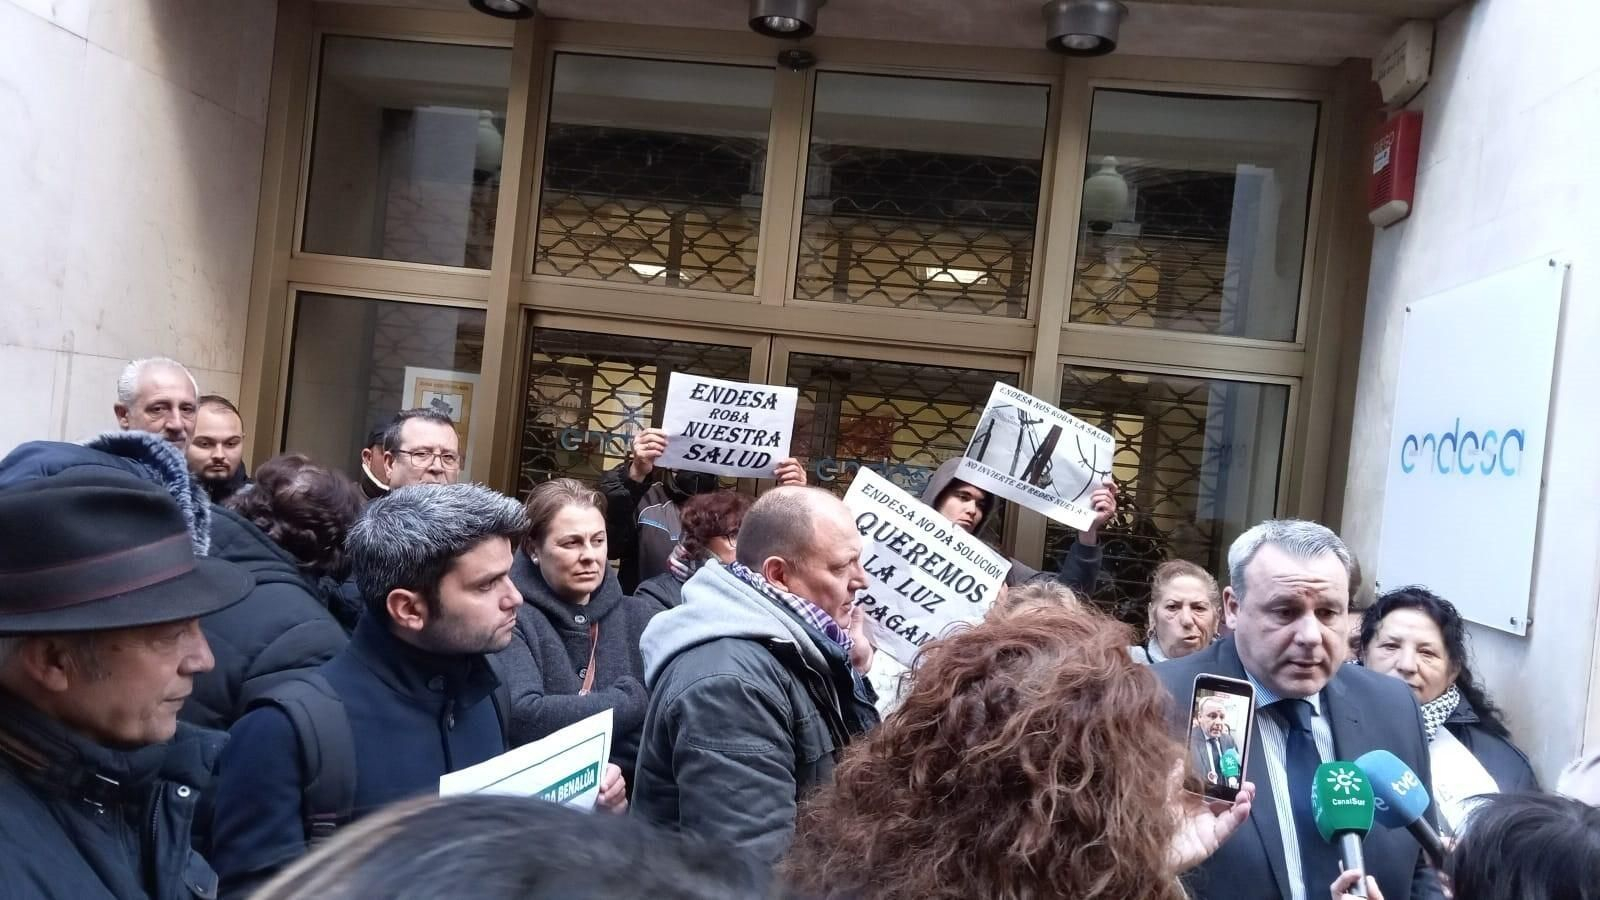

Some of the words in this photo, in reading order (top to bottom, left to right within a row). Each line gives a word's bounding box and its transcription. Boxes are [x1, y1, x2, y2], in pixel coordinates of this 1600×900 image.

[689, 383, 777, 410] ENDESA
[708, 408, 750, 424] ROBA
[999, 387, 1033, 406] ENDESA
[1033, 401, 1051, 415] NOS
[1051, 410, 1073, 426] ROBA
[1086, 427, 1111, 444] SALUD
[680, 421, 781, 447] NUESTRA
[1401, 417, 1524, 476] endesa
[682, 444, 771, 469] SALUD
[965, 461, 978, 470] NO
[977, 465, 1019, 487] INVIERTE
[1015, 481, 1029, 493] EN
[1029, 486, 1059, 503] REDES
[861, 483, 915, 521] ENDESA
[915, 517, 936, 533] NO
[934, 529, 954, 546] DA
[953, 541, 1003, 580] SOLUCIÓN
[855, 511, 989, 604] QUEREMOS
[863, 554, 897, 584] LA
[894, 578, 946, 614] LUZ
[558, 768, 595, 802] BENALÚA
[1391, 771, 1418, 796] tve
[1332, 797, 1366, 806] CanalSur
